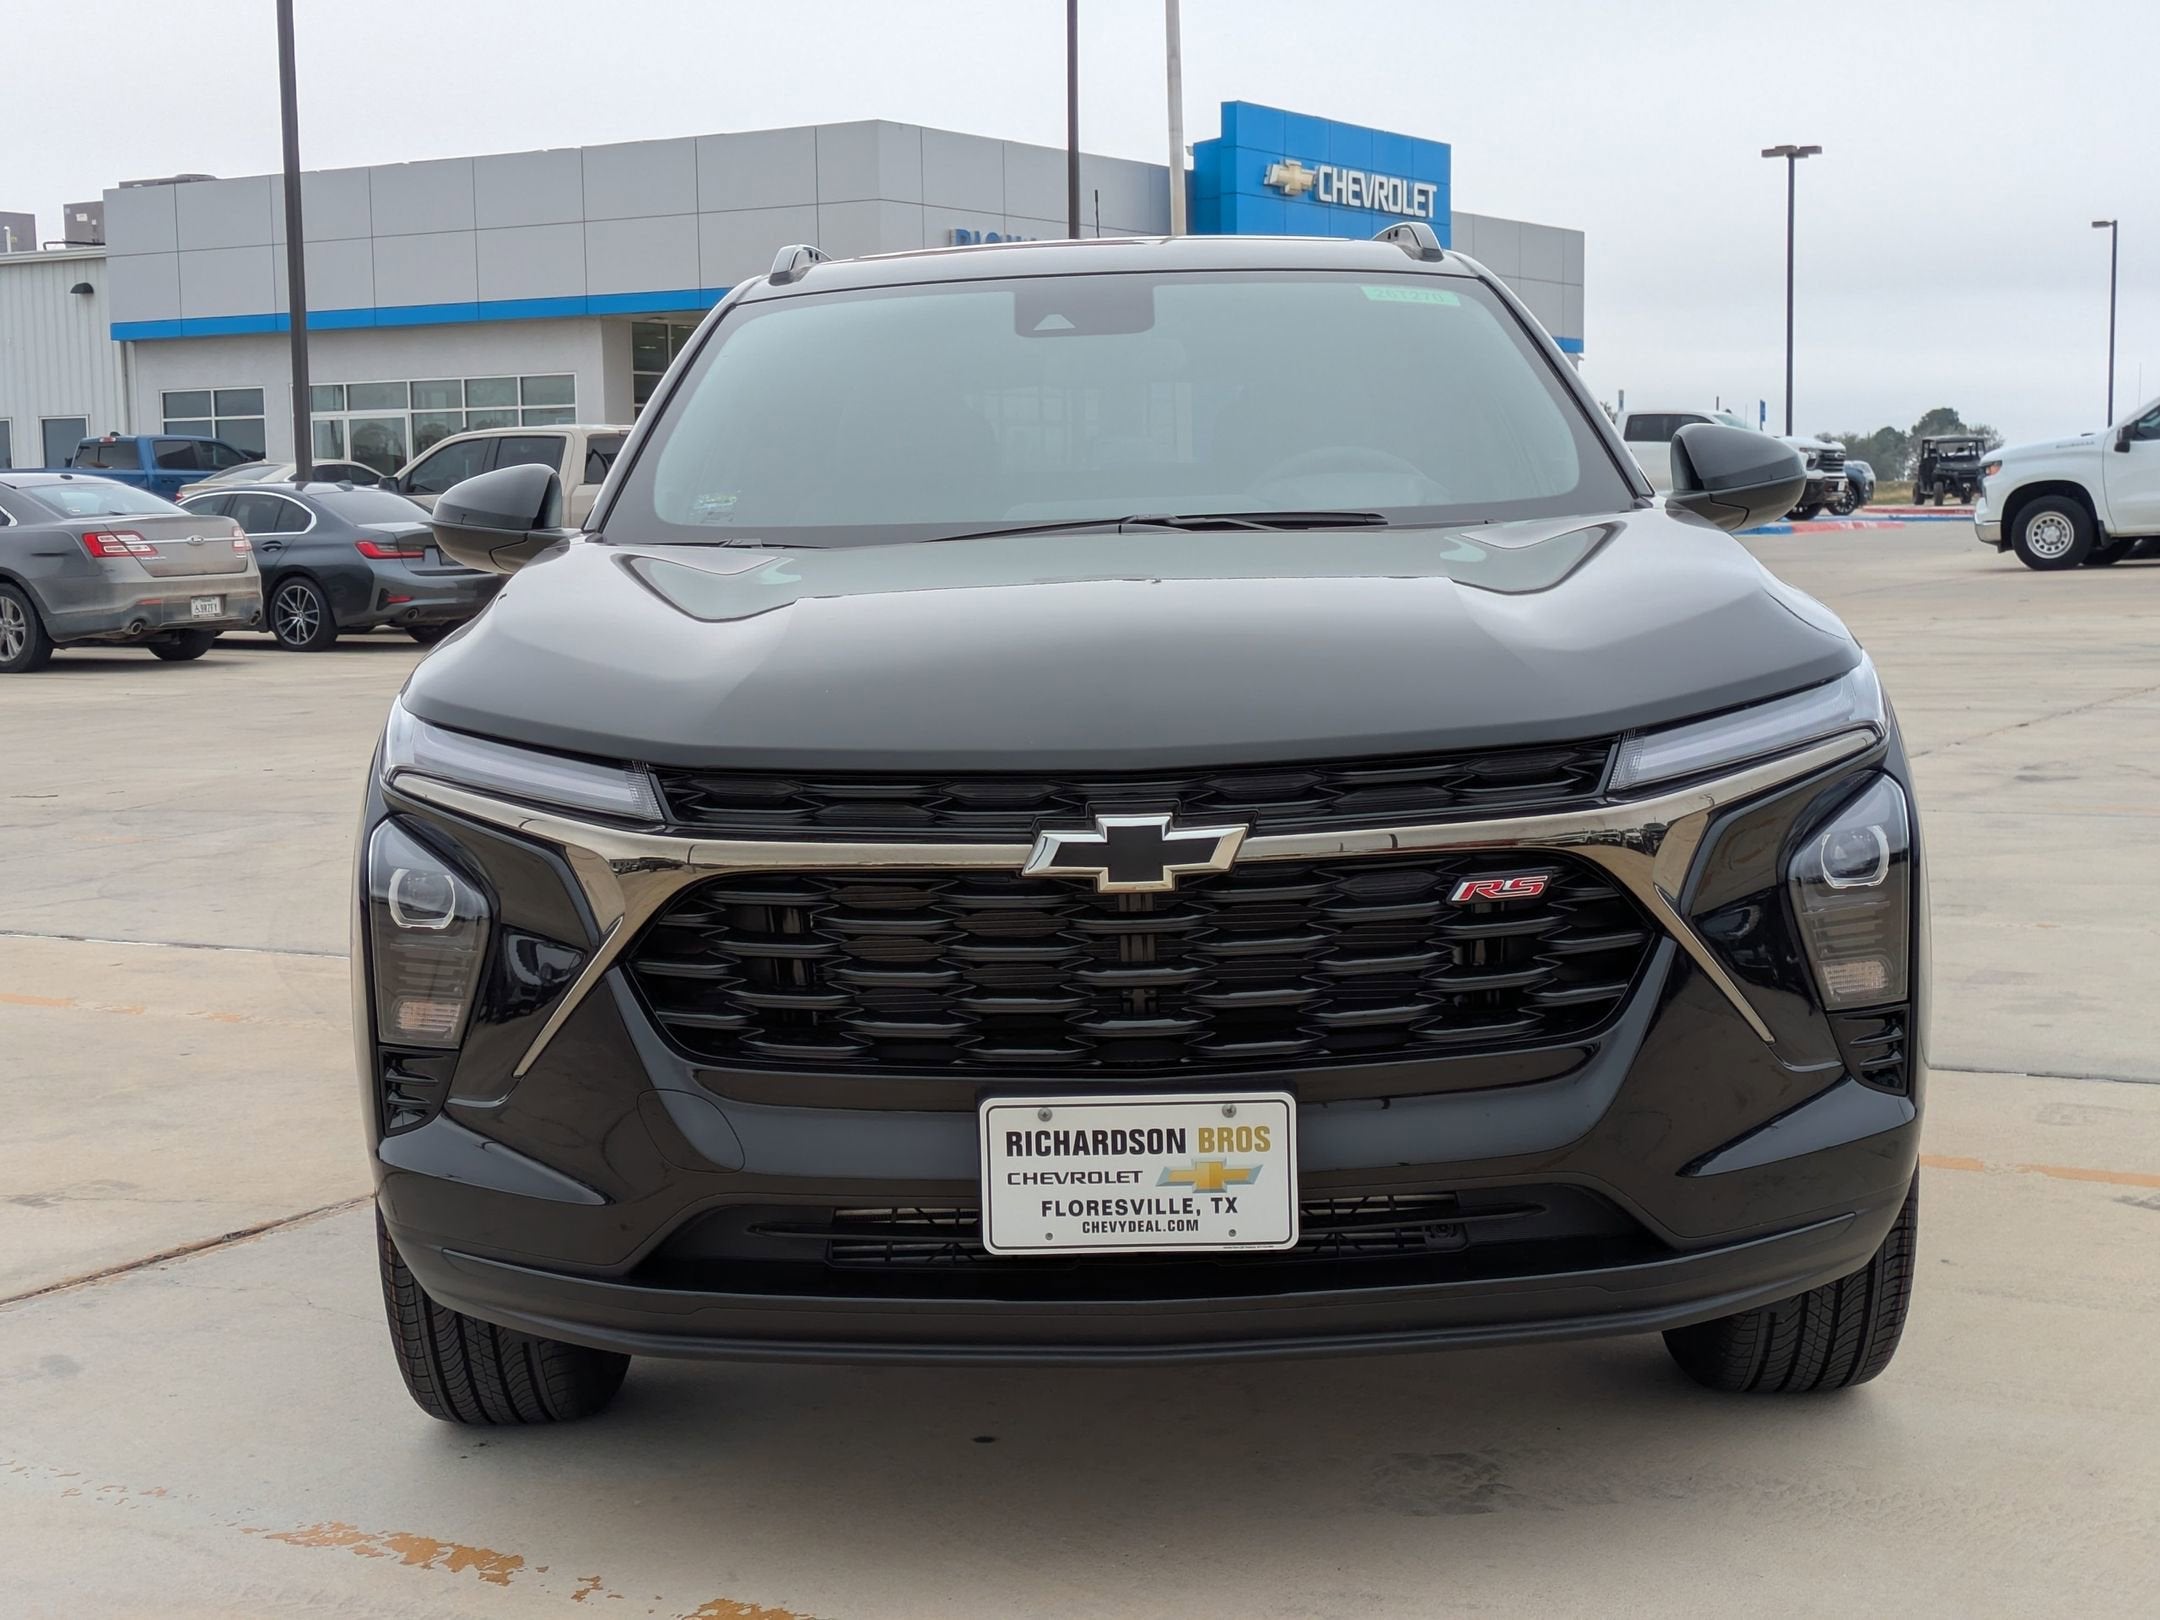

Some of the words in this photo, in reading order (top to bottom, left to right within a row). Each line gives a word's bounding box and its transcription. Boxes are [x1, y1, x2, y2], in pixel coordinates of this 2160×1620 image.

[1319, 165, 1437, 218] CHEVROLET
[1451, 875, 1548, 901] RS
[1005, 1128, 1187, 1157] RICHARDSON
[1198, 1126, 1271, 1153] BROS
[1007, 1170, 1143, 1185] CHEVROLET
[1041, 1197, 1201, 1217] FLORESVILLE,
[1210, 1196, 1238, 1214] TX
[1082, 1219, 1199, 1234] CHEVYDEAL.COM
